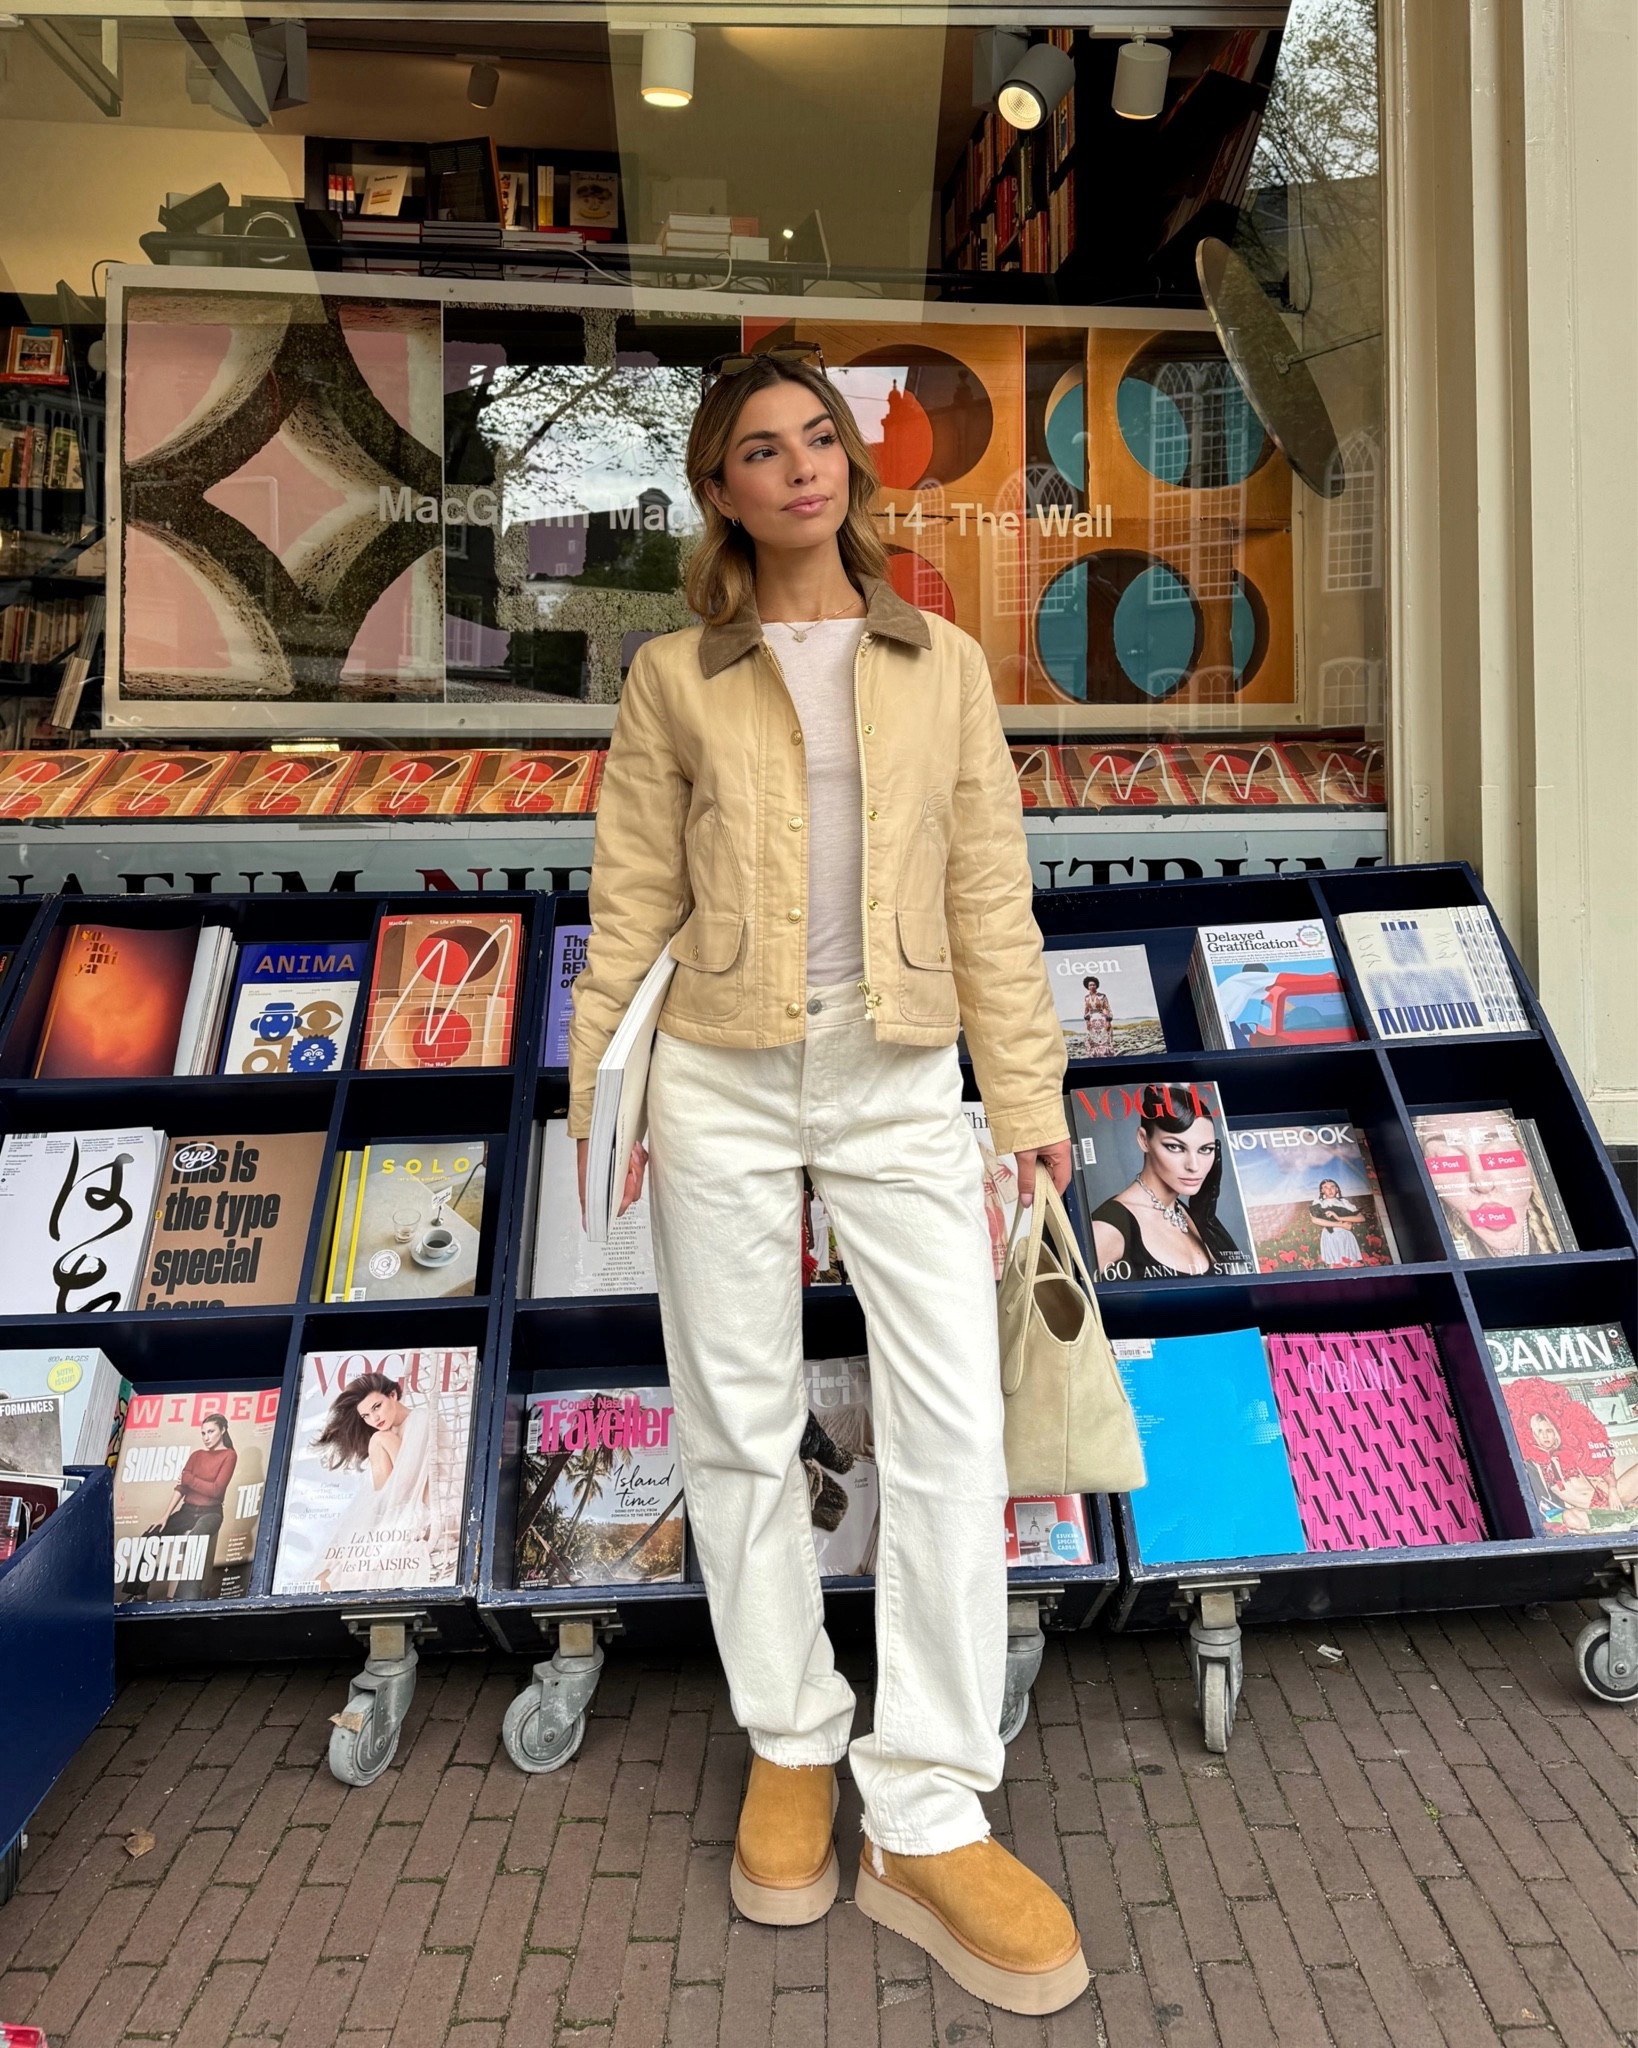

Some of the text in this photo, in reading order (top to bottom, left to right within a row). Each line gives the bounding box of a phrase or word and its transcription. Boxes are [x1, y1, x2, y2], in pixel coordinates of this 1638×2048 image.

[884, 502, 926, 535] 14
[951, 503, 1020, 537] The
[1036, 504, 1112, 537] Wall
[1205, 930, 1264, 944] Delayed
[1208, 939, 1299, 952] Gratification
[255, 954, 355, 974] ANIMA
[563, 949, 587, 961] EU
[1056, 958, 1123, 976] deem
[1075, 1084, 1221, 1122] VOGUE
[1228, 1125, 1355, 1151] NOTEBOOK
[176, 1146, 214, 1169] eye
[229, 1141, 259, 1183] is
[381, 1157, 470, 1174] SOLO
[1442, 1161, 1460, 1169] Post
[1498, 1156, 1516, 1164] Post
[163, 1187, 281, 1238] the type
[1488, 1213, 1507, 1222] Post
[151, 1237, 262, 1295] special
[1104, 1260, 1131, 1281] 60
[1143, 1265, 1179, 1278] ANNI
[1213, 1262, 1253, 1276] STILE
[314, 1352, 470, 1397] VOGUE
[1308, 1348, 1402, 1394] CABANA
[0, 1400, 54, 1417] FORMANCES
[131, 1391, 280, 1425] WIRED
[537, 1395, 675, 1453] Traveller
[1591, 1447, 1638, 1459] and INTIM
[1609, 1438, 1633, 1449] Sport
[122, 1446, 191, 1483] SMASH
[613, 1463, 675, 1491] Island
[235, 1482, 265, 1520] THE
[351, 1529, 411, 1545] La MODE
[114, 1534, 210, 1584] SYSTEM
[324, 1545, 382, 1560] DE TOUS
[342, 1557, 420, 1573] les PLAISIRS
